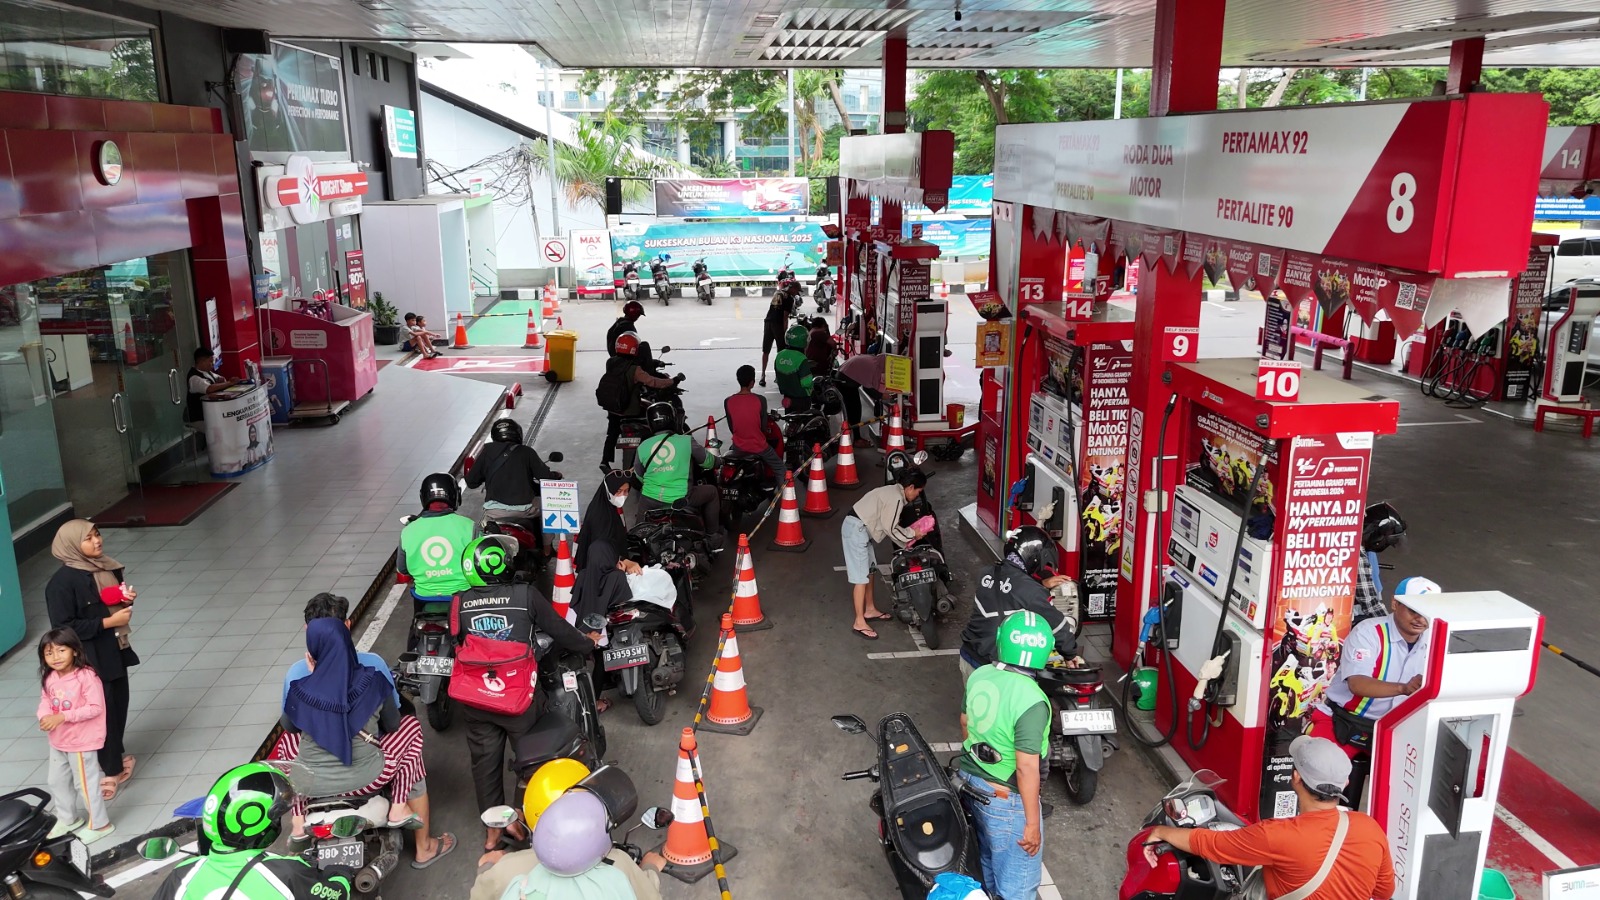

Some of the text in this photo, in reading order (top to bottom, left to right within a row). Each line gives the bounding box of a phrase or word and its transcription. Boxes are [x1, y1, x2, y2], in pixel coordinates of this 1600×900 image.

[287, 83, 338, 107] PERTAMAX TURBO
[1222, 130, 1309, 154] PERTAMAX 92
[1123, 144, 1174, 166] RODA DUA
[1560, 149, 1581, 169] 14
[1128, 175, 1162, 198] MOTOR
[1386, 171, 1415, 234] 8
[1216, 197, 1294, 228] PERTALITE 90
[845, 217, 856, 226] 27
[856, 220, 868, 230] 28
[871, 228, 885, 239] 23
[887, 233, 900, 245] 24
[912, 227, 923, 237] 22
[579, 236, 602, 244] MAX
[644, 233, 813, 249] SUKSESKAN BULAN K3 NASIONAL 2025
[1229, 249, 1253, 263] MotoGP
[350, 272, 365, 286] 80%
[1285, 269, 1312, 281] BANYAK
[1020, 284, 1045, 300] 13
[1517, 289, 1542, 298] MotoGP
[1066, 300, 1093, 319] 14
[1172, 335, 1189, 357] 9
[1258, 370, 1300, 398] 10
[1090, 387, 1127, 399] HANYA
[1090, 398, 1129, 410] MyPERTAMI
[1089, 409, 1129, 421] BELI TIK
[1197, 414, 1262, 449] GRATIS TIKET MotoGP
[1087, 434, 1128, 447] BANYA
[1087, 447, 1126, 456] UNTUNGN
[1294, 478, 1357, 488] PERTAMINA GRAND PRIX
[1293, 487, 1345, 497] OF INDONESIA 2024
[1289, 499, 1360, 517] HANYA DI
[1288, 516, 1359, 532] MyPERTAMINA
[1286, 531, 1357, 549] BELI TIKET
[1284, 548, 1351, 569] MotoGP
[425, 567, 454, 578] gojek
[1282, 567, 1353, 586] BANYAK
[1281, 584, 1351, 599] UNTUNGNYA
[462, 597, 511, 609] COMMUNITY
[474, 617, 506, 631] KBGG
[1009, 629, 1047, 649] Grab
[611, 649, 631, 660] 3959
[1063, 712, 1112, 723] B 4373 TYK
[1271, 757, 1294, 765] Dapatka
[1394, 743, 1418, 892] SELF SERVICE
[342, 844, 361, 857] SCX
